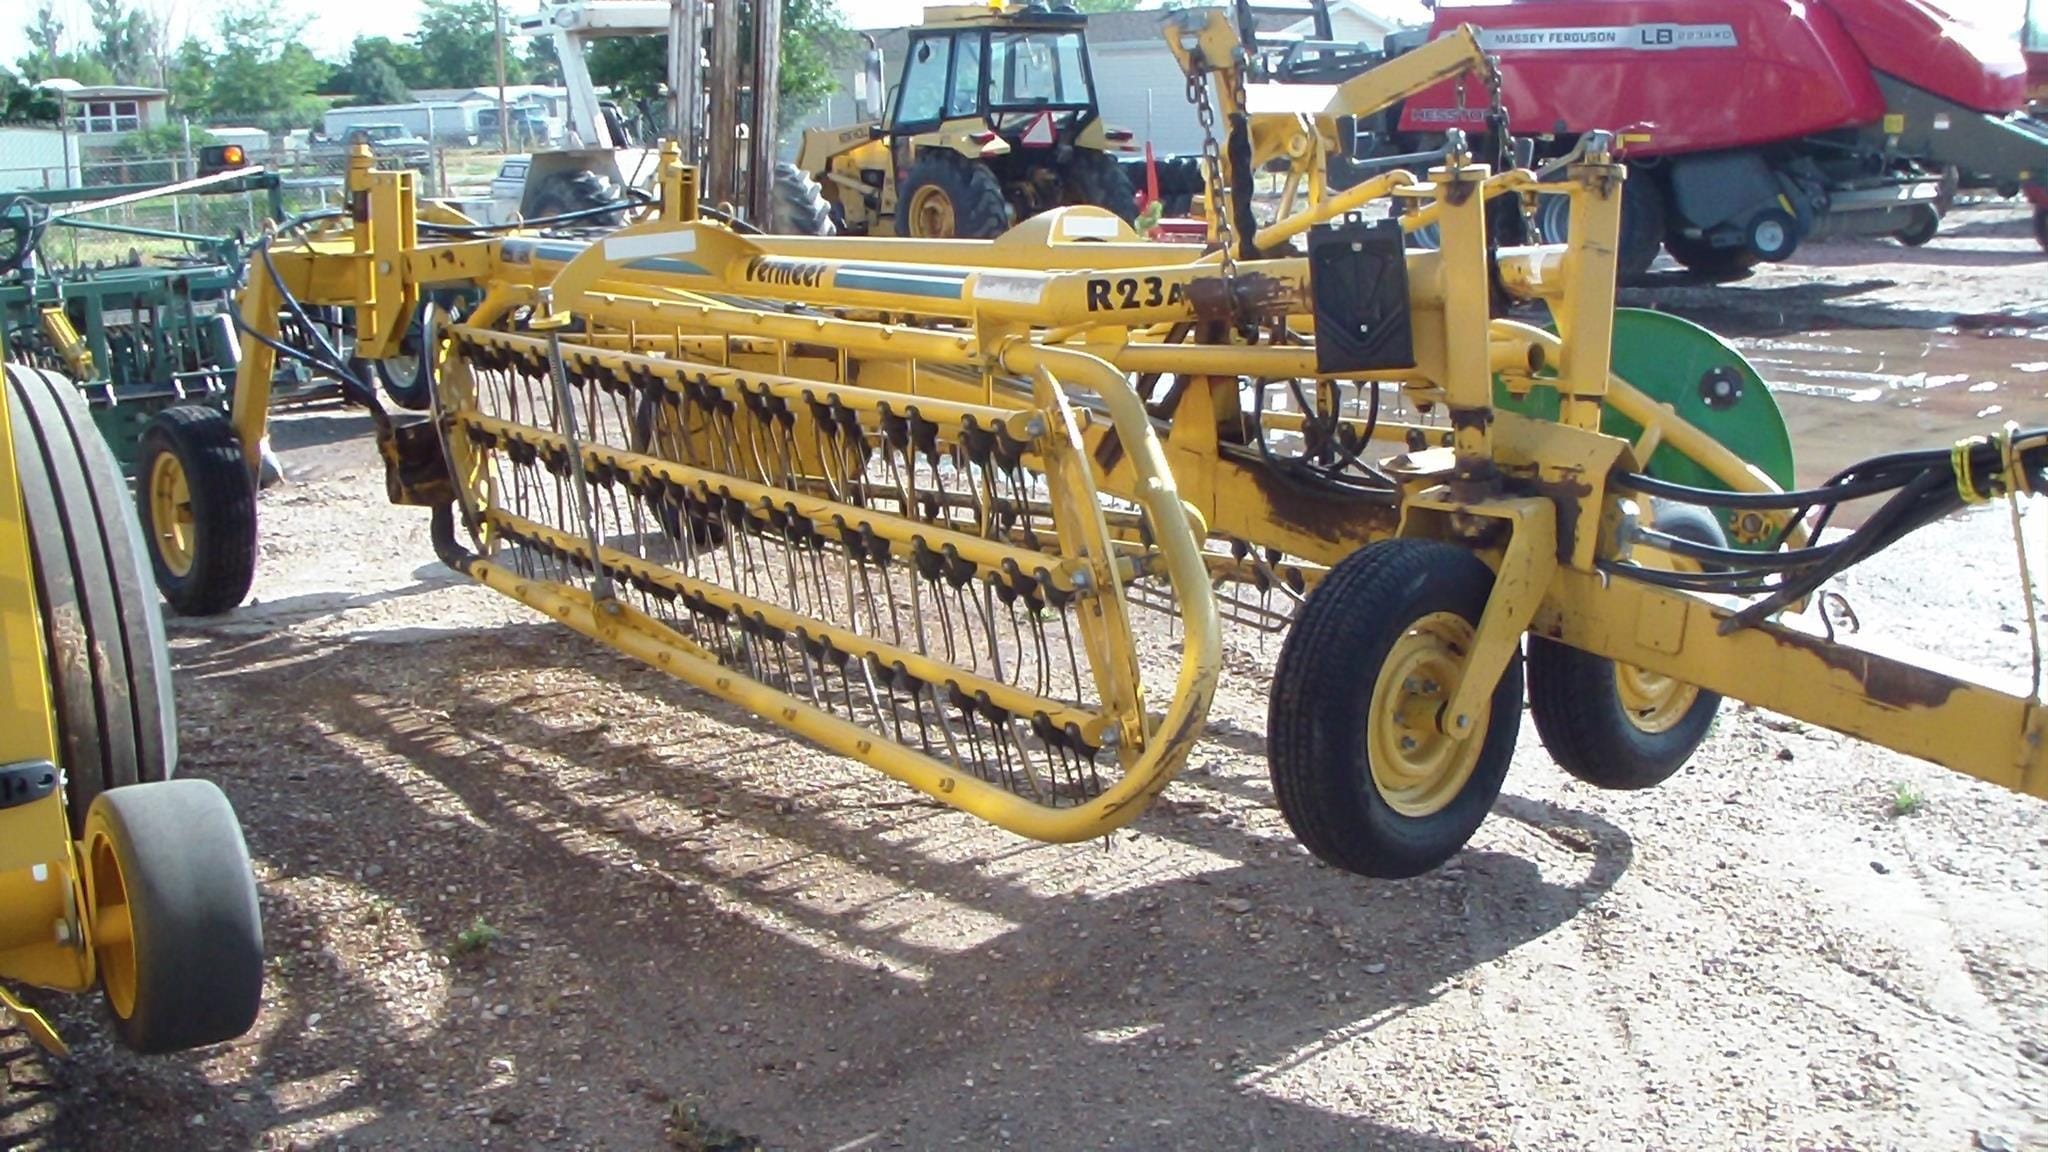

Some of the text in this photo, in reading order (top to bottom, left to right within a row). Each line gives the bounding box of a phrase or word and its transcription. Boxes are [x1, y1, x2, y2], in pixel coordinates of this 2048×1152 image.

[1495, 33, 1545, 44] MASSEY
[1549, 31, 1616, 43] FERGUSON
[1641, 28, 1673, 45] LB
